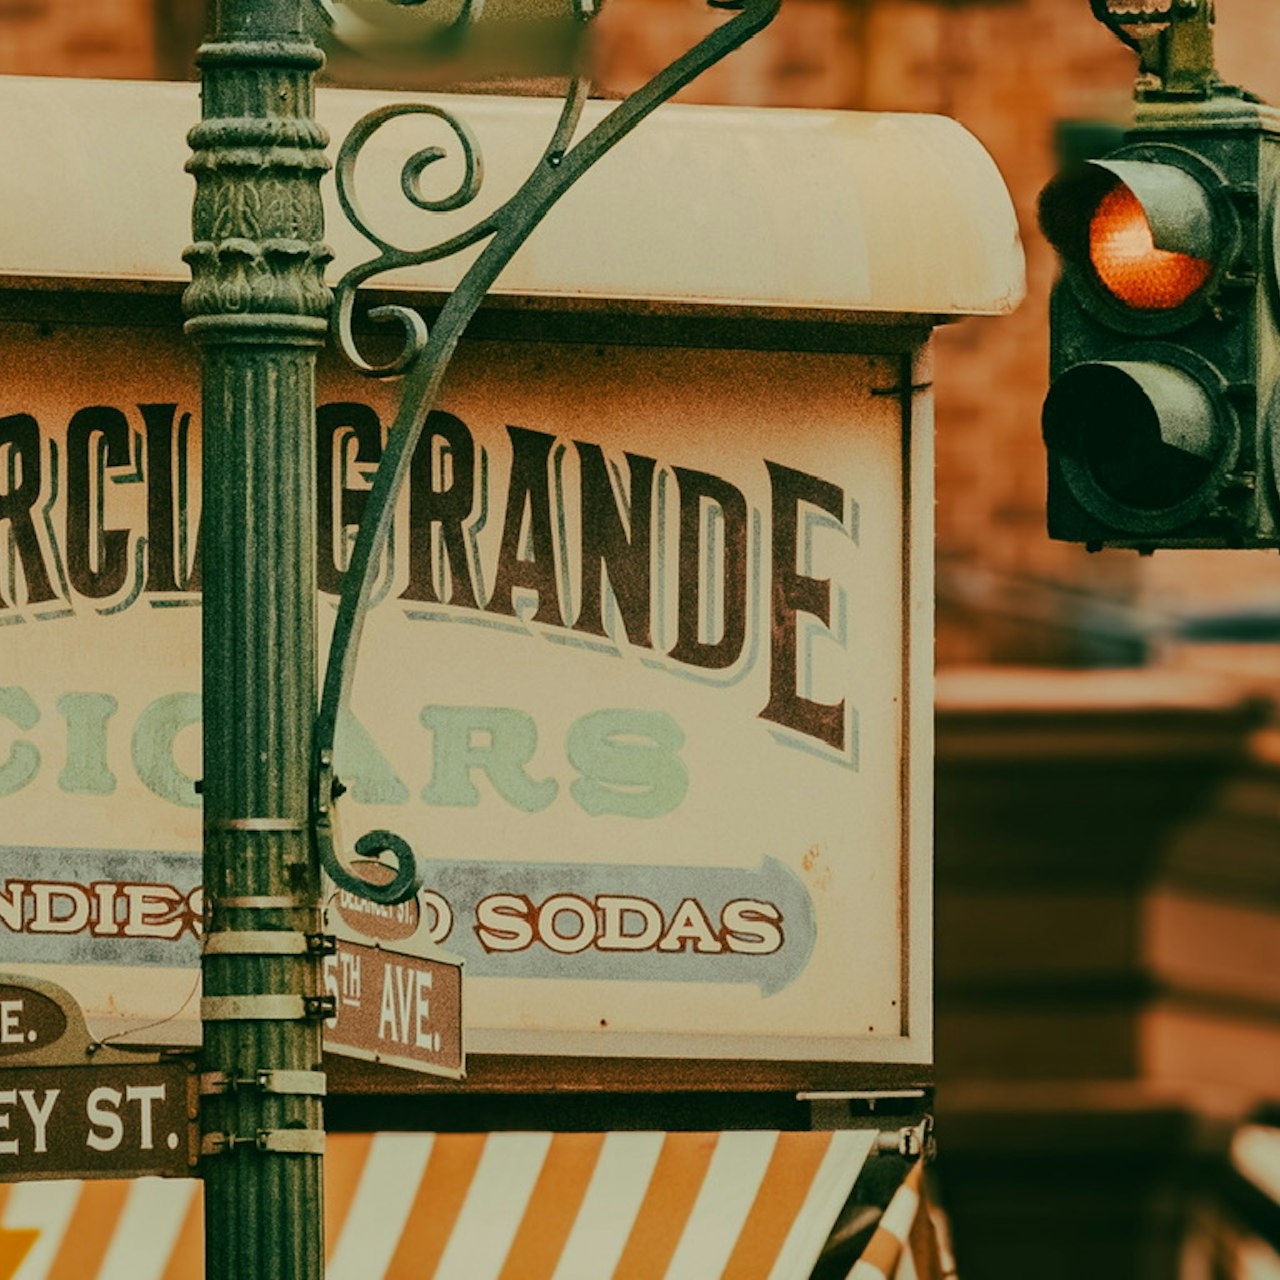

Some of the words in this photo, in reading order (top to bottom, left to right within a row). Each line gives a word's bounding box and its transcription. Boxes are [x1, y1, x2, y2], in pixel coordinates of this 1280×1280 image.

[316, 400, 859, 770] GRANDE
[473, 892, 785, 956] SODAS
[377, 962, 442, 1053] AVE.
[86, 1084, 181, 1151] ST.
